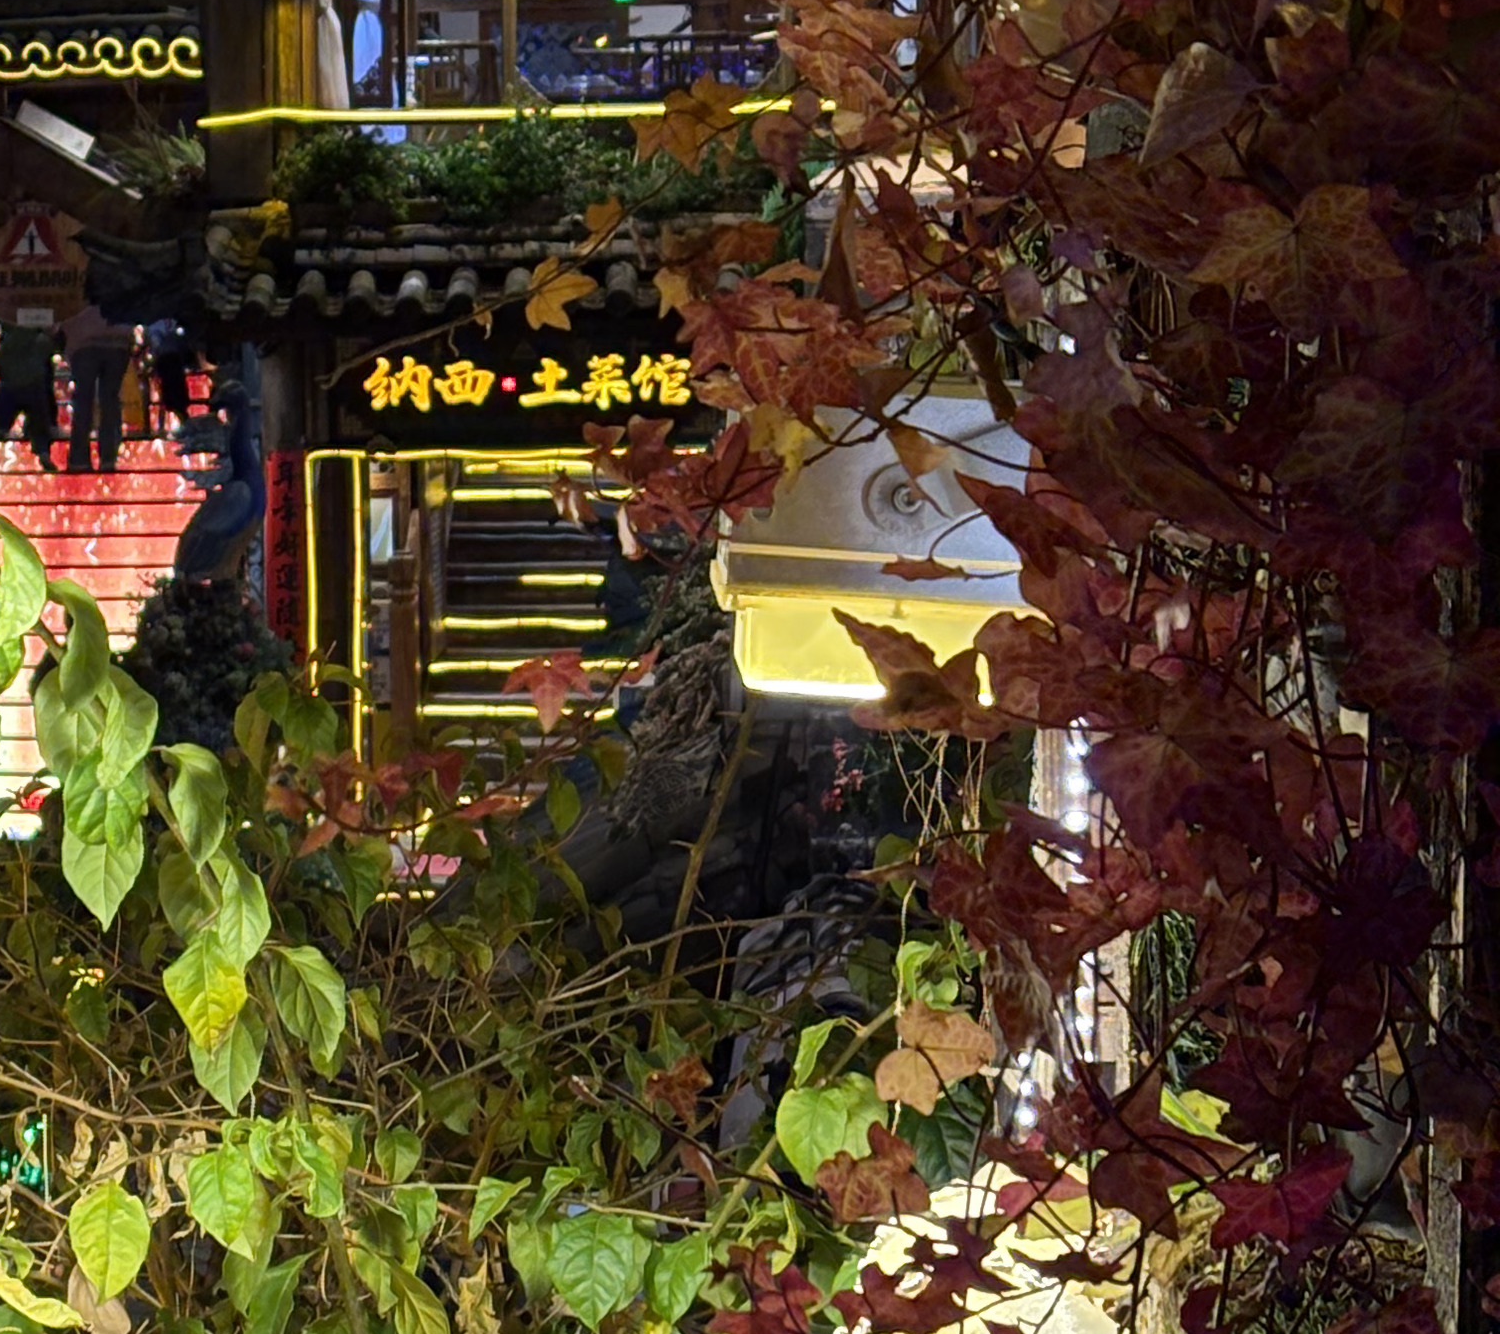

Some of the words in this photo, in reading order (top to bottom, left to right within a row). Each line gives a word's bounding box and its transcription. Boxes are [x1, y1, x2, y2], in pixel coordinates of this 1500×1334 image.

[362, 353, 693, 414] 纳西·土菜馆
